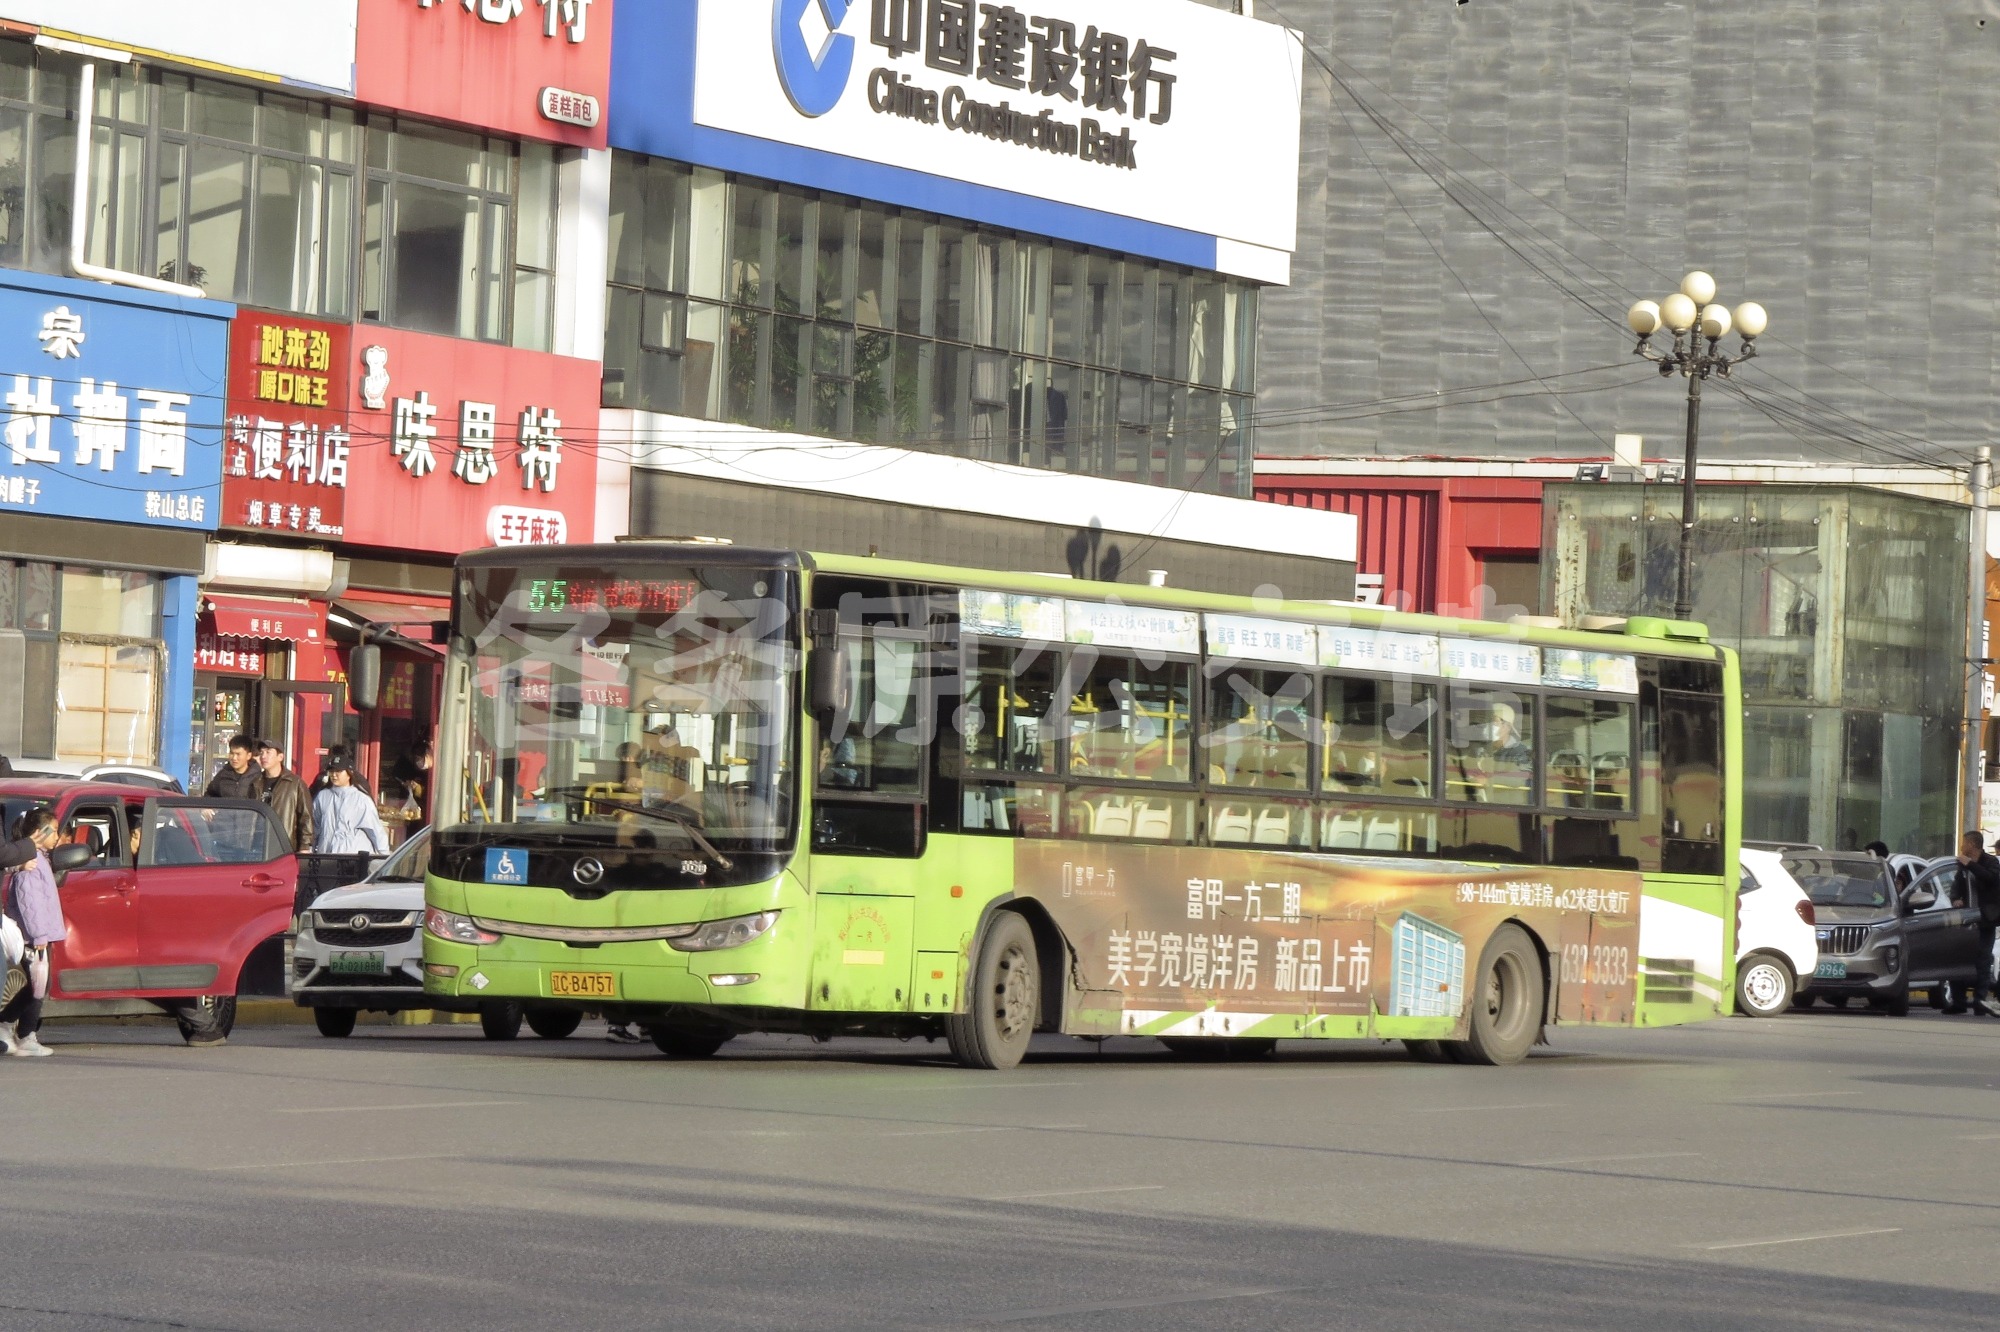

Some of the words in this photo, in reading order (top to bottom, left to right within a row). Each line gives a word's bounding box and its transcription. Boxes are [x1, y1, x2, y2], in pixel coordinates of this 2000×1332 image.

[870, 0, 1178, 125] 中国建设银行
[549, 92, 592, 122] 蛋糕面包
[868, 67, 939, 126] China
[942, 85, 1079, 157] Construction
[1079, 117, 1138, 171] Bank
[252, 416, 350, 488] 便利店
[390, 391, 563, 493] 味思特
[145, 491, 205, 523] 鞍山总店
[248, 499, 322, 535] 烟草专卖
[500, 514, 560, 545] 王子麻花
[528, 580, 567, 613] 55
[250, 618, 283, 634] 便利店
[1241, 628, 1258, 647] 民主
[1263, 631, 1281, 650] 文明
[238, 652, 260, 672] 专卖
[1335, 639, 1351, 656] 自由
[1357, 640, 1375, 658] 平等
[1075, 866, 1116, 888] 富甲一方
[1187, 877, 1301, 923] 富甲一方二期
[1108, 929, 1259, 991] 美学宽境洋房
[1274, 936, 1372, 993] 新品上市
